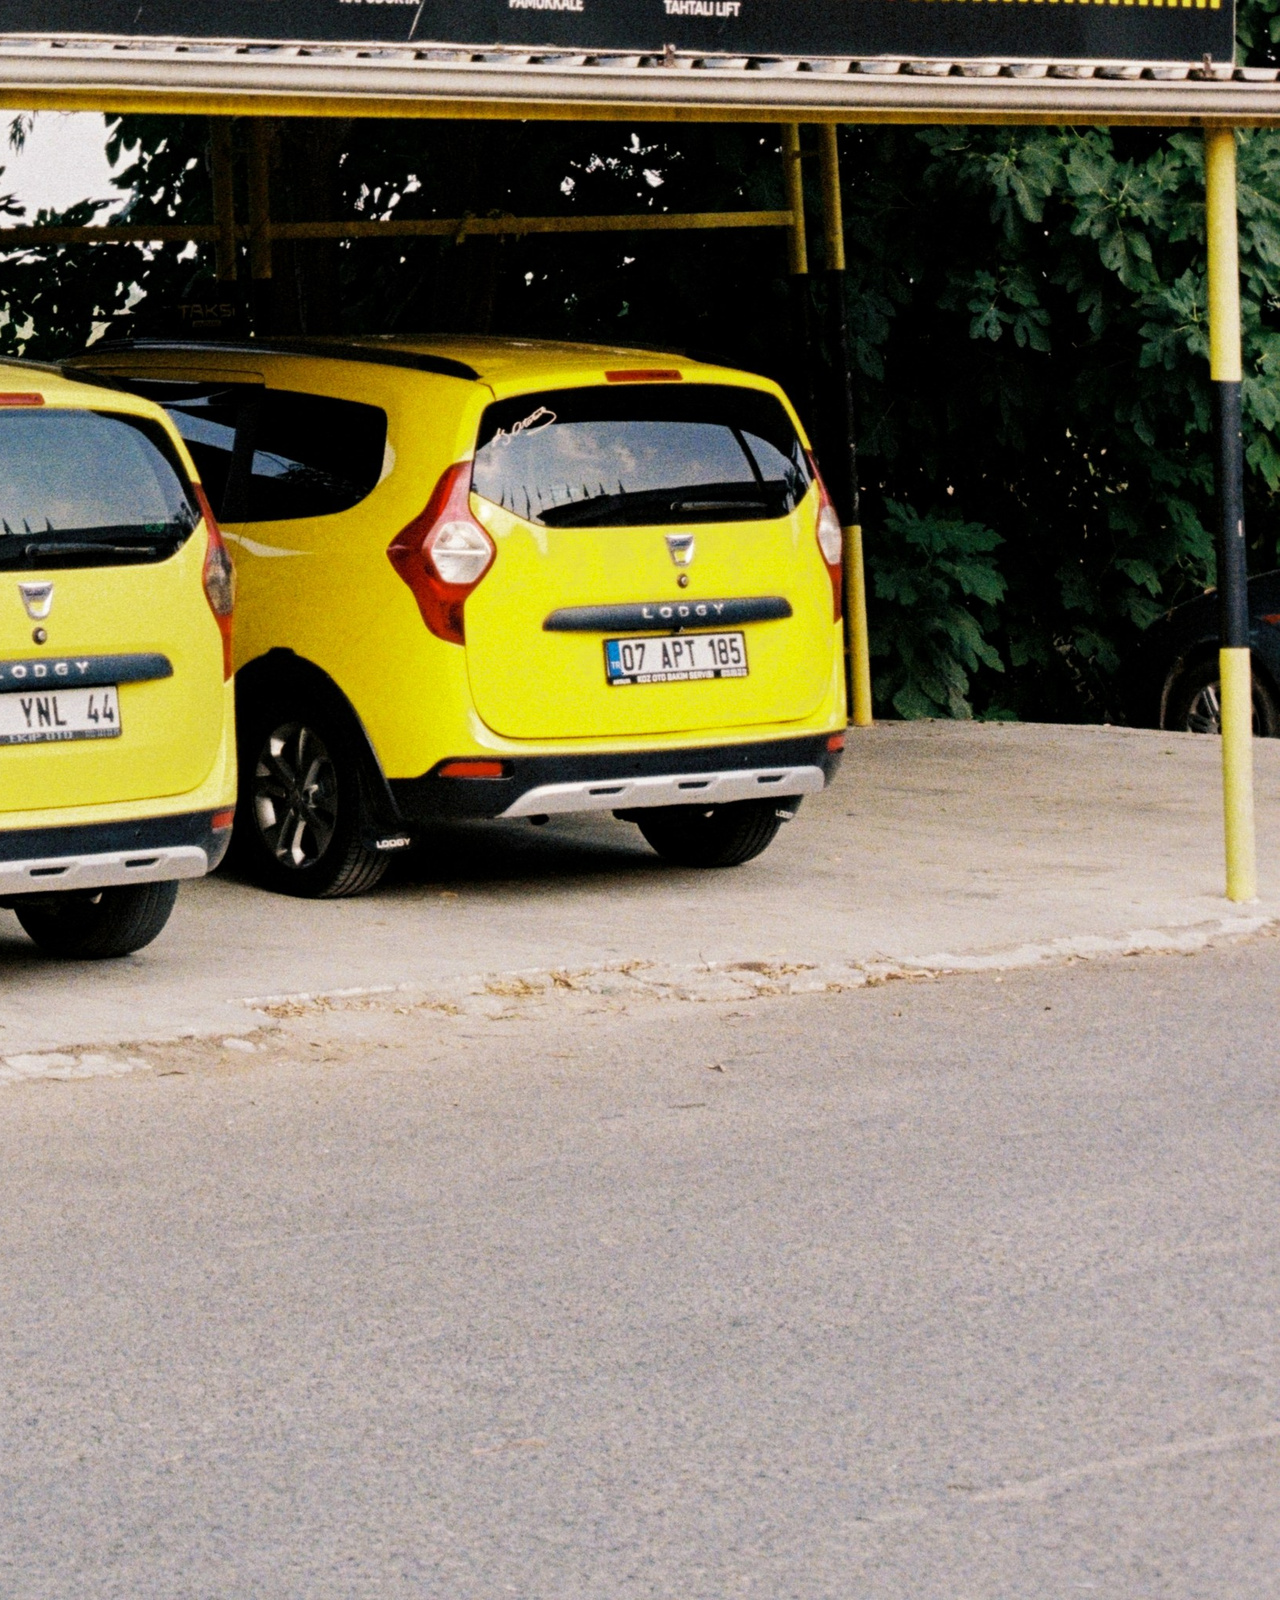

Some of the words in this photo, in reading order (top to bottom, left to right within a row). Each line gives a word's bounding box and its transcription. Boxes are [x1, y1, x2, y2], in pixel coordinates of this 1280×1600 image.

[663, 0, 714, 16] TAHTALI
[716, 1, 741, 17] LIFT
[642, 603, 723, 618] LODGY
[611, 660, 620, 669] TR
[622, 643, 645, 671] 07
[662, 639, 695, 668] APT
[708, 637, 741, 665] 185
[20, 696, 66, 728] YNL
[87, 694, 114, 723] 44
[376, 837, 411, 849] LODGY
